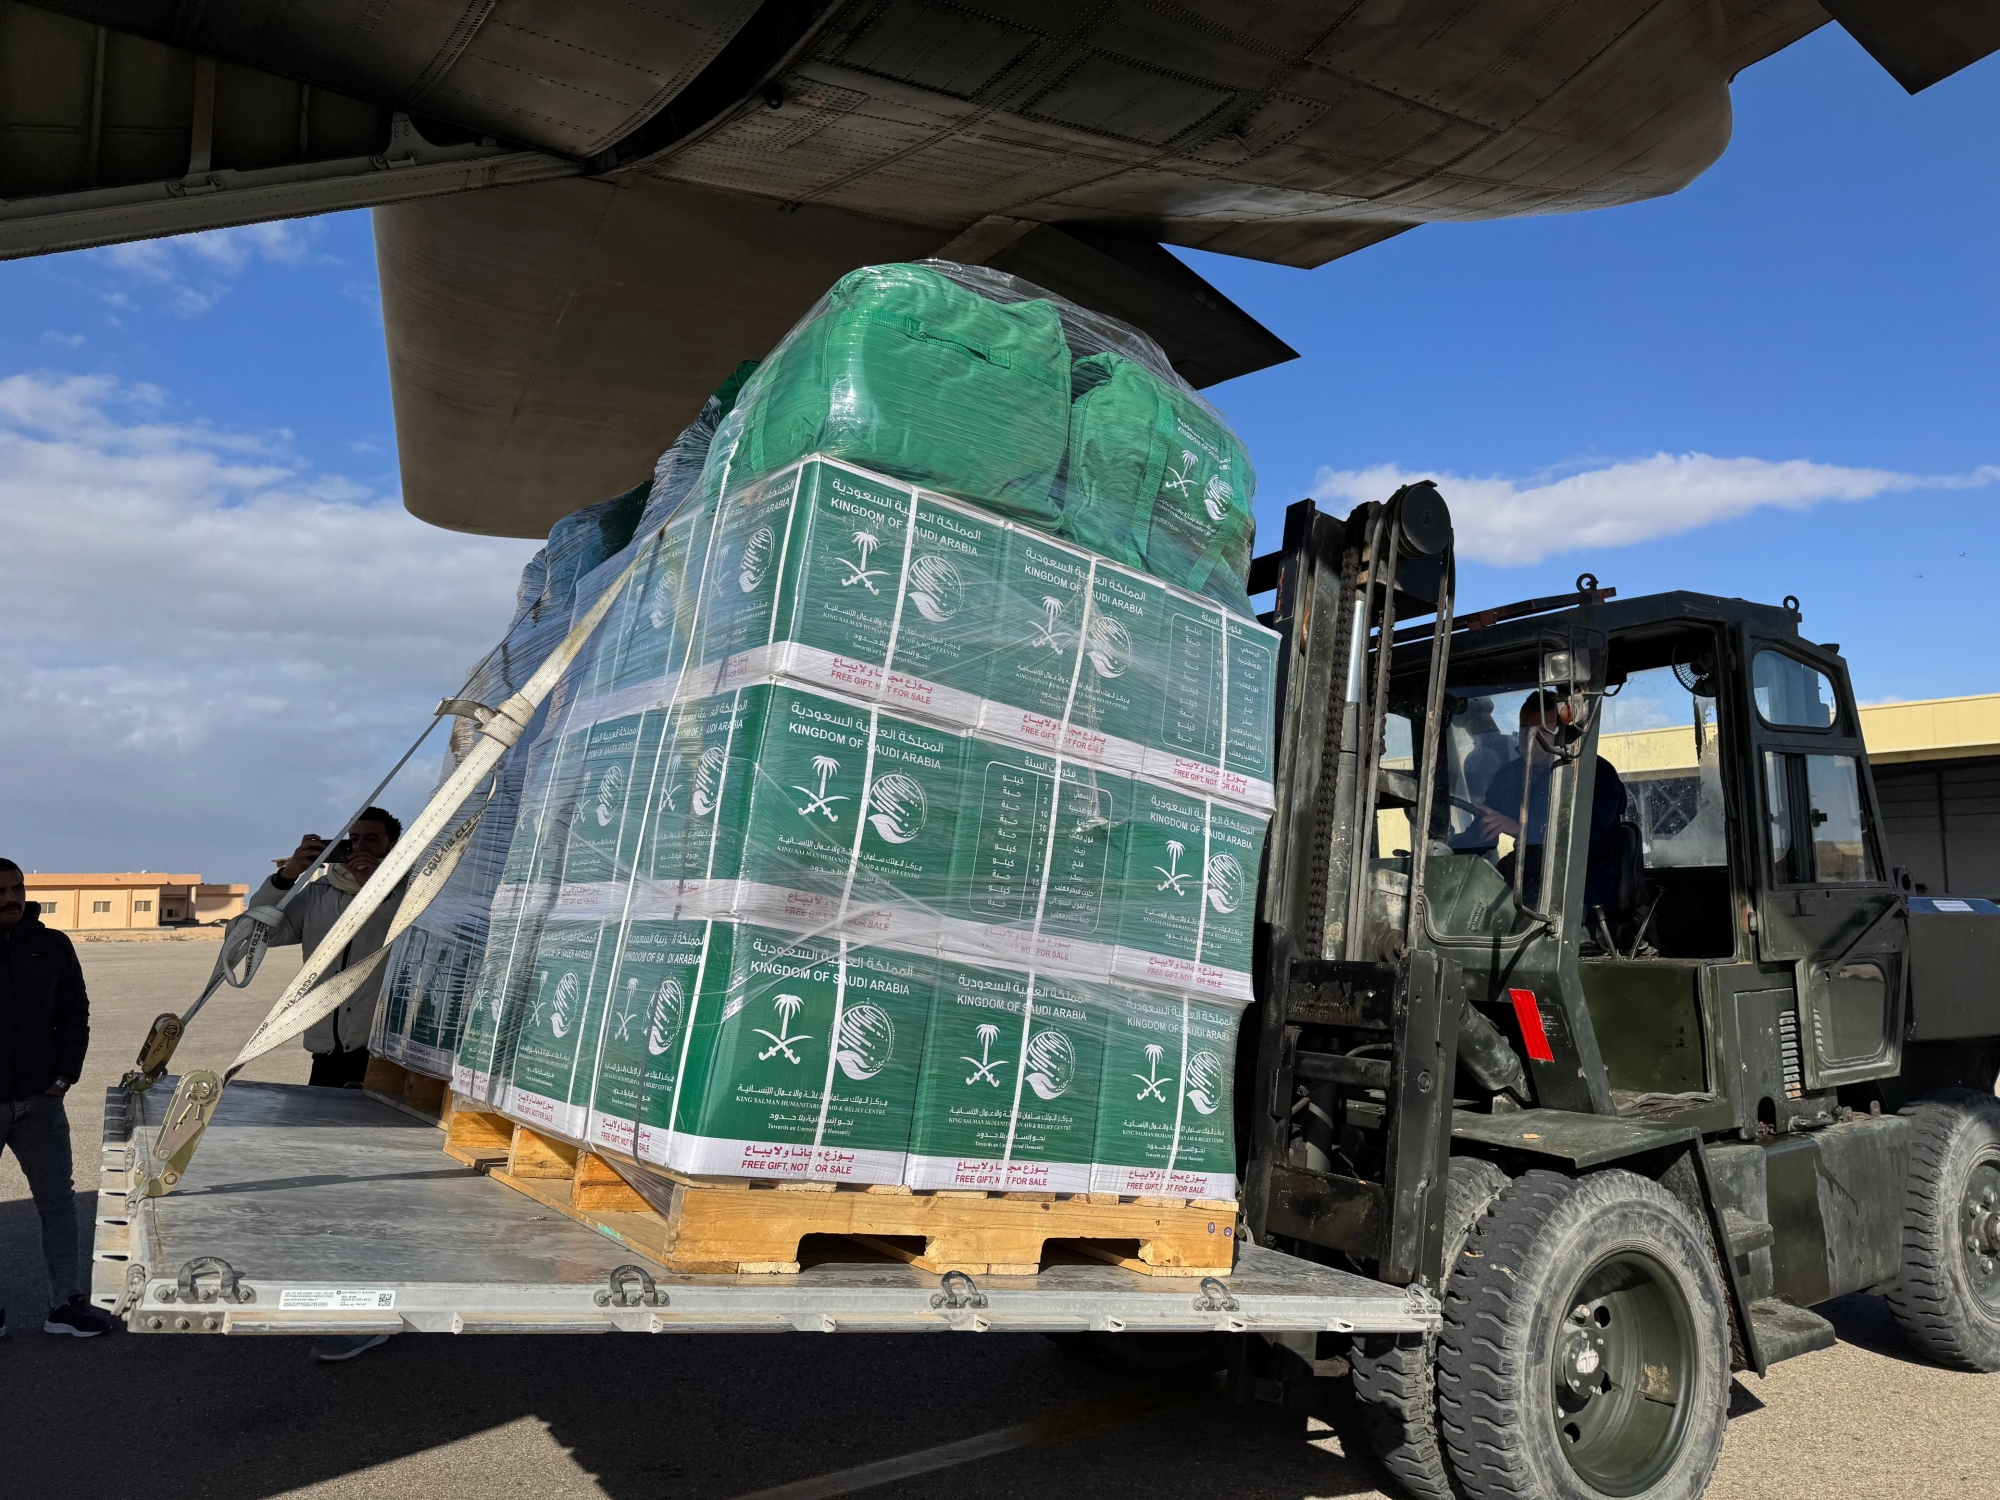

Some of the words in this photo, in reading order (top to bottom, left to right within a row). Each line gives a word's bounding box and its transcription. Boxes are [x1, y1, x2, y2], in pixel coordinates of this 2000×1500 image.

[831, 478, 893, 512] السعودية
[829, 496, 885, 525] KINGDOM
[887, 515, 903, 531] OF
[939, 533, 979, 556] ARABIA
[935, 514, 982, 541] المملكة
[1023, 563, 1069, 588] KINGDOM
[1068, 579, 1083, 594] OF
[1111, 595, 1144, 616] ARABIA
[830, 669, 853, 683] FREE
[874, 681, 892, 694] NT
[892, 686, 909, 699] FOR
[909, 691, 932, 704] SALE
[789, 699, 853, 730] السعودية
[787, 719, 846, 745] KINGDOM
[847, 735, 864, 750] OF
[900, 749, 943, 770] ARABIA
[897, 728, 946, 753] المملكة
[1020, 724, 1039, 737] FREE
[1071, 738, 1086, 750] FOR
[1086, 742, 1105, 755] SALE
[1024, 755, 1048, 771] السلة
[1043, 783, 1049, 791] 7
[1173, 767, 1189, 779] FREE
[1205, 776, 1217, 787] NOT
[1230, 784, 1246, 796] SALE
[1042, 796, 1048, 805] 2
[1038, 823, 1047, 832] 16
[1150, 812, 1189, 832] KINGDOM
[1189, 823, 1201, 835] OF
[1225, 834, 1253, 851] ARABIA
[1038, 837, 1044, 846] 2
[1036, 851, 1041, 859] 1
[1034, 864, 1040, 873] 3
[1031, 877, 1040, 886] 15
[852, 916, 867, 928] OR
[866, 919, 890, 932] SALE
[655, 952, 674, 963] SADI
[674, 953, 701, 965] ARABIA
[751, 937, 819, 965] السعودية
[1020, 944, 1031, 954] NO
[1035, 947, 1051, 958] FOR
[1051, 950, 1069, 961] SALE
[749, 958, 811, 980] KINGDOM
[812, 969, 830, 983] OF
[868, 978, 912, 997] ARABIA
[864, 957, 915, 980] المملكة
[1147, 965, 1164, 977] FREE
[1179, 972, 1193, 982] NOT
[1196, 975, 1206, 985] OR
[1206, 977, 1222, 988] SALE
[957, 972, 1012, 994] السعودية
[1049, 986, 1090, 1004] المملكة
[956, 992, 1005, 1010] KINGDOM
[1006, 1000, 1021, 1012] OF
[1052, 1006, 1088, 1021] ARABIA
[735, 1095, 753, 1104] KING
[753, 1096, 781, 1106] SALMAN
[740, 1157, 766, 1169] FREE
[789, 1161, 809, 1172] NOT
[813, 1163, 829, 1174] OR
[828, 1164, 853, 1175] SALE
[954, 1172, 975, 1183] FREE
[994, 1175, 1011, 1185] NT
[1011, 1176, 1027, 1186] FOR
[1027, 1177, 1048, 1187] SALE
[1126, 1179, 1144, 1190] FREE
[1174, 1183, 1188, 1193] FOR
[1188, 1184, 1205, 1194] SALE
